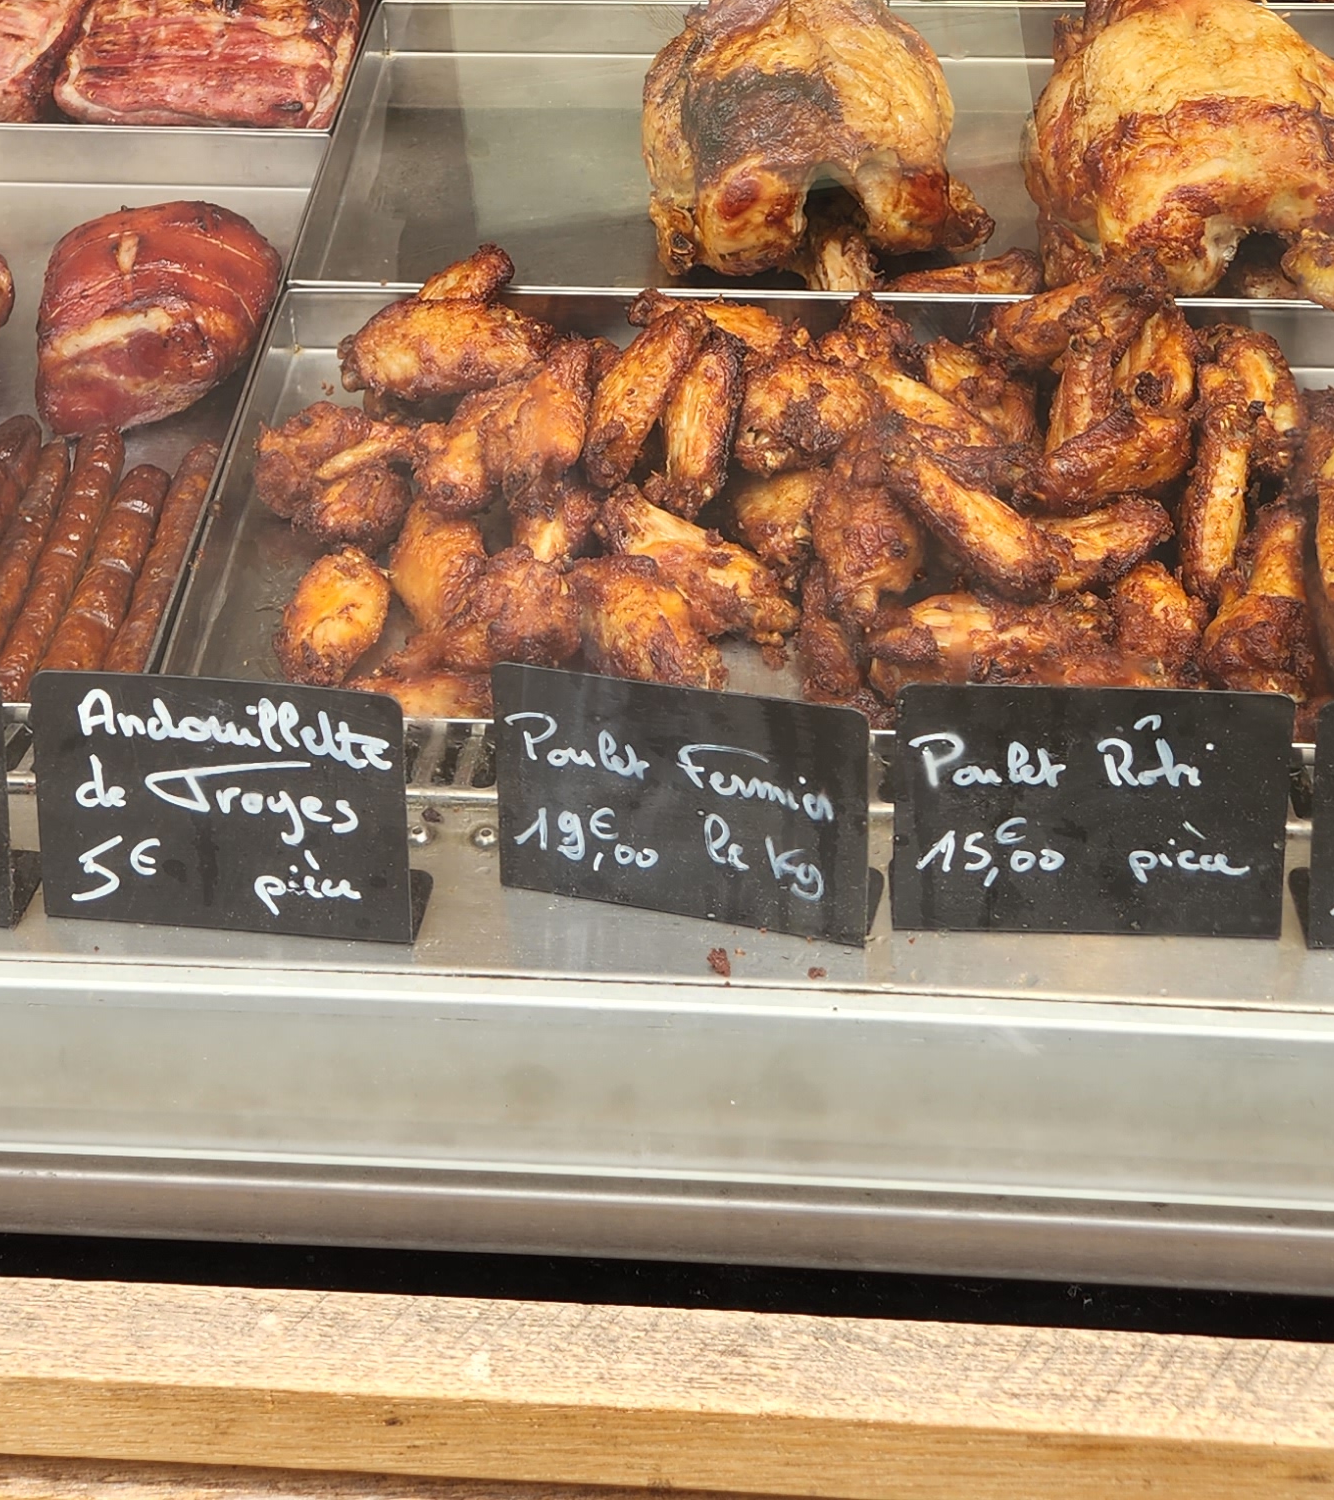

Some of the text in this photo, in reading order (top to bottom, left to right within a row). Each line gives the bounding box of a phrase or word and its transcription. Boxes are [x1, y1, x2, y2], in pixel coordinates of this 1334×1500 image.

[77, 688, 393, 770] Andouillette
[504, 711, 650, 781] Poulet
[908, 714, 1215, 788] Poulet Rôti
[75, 754, 359, 846] de Troyes
[704, 813, 750, 871] le
[1128, 820, 1251, 884] pièce
